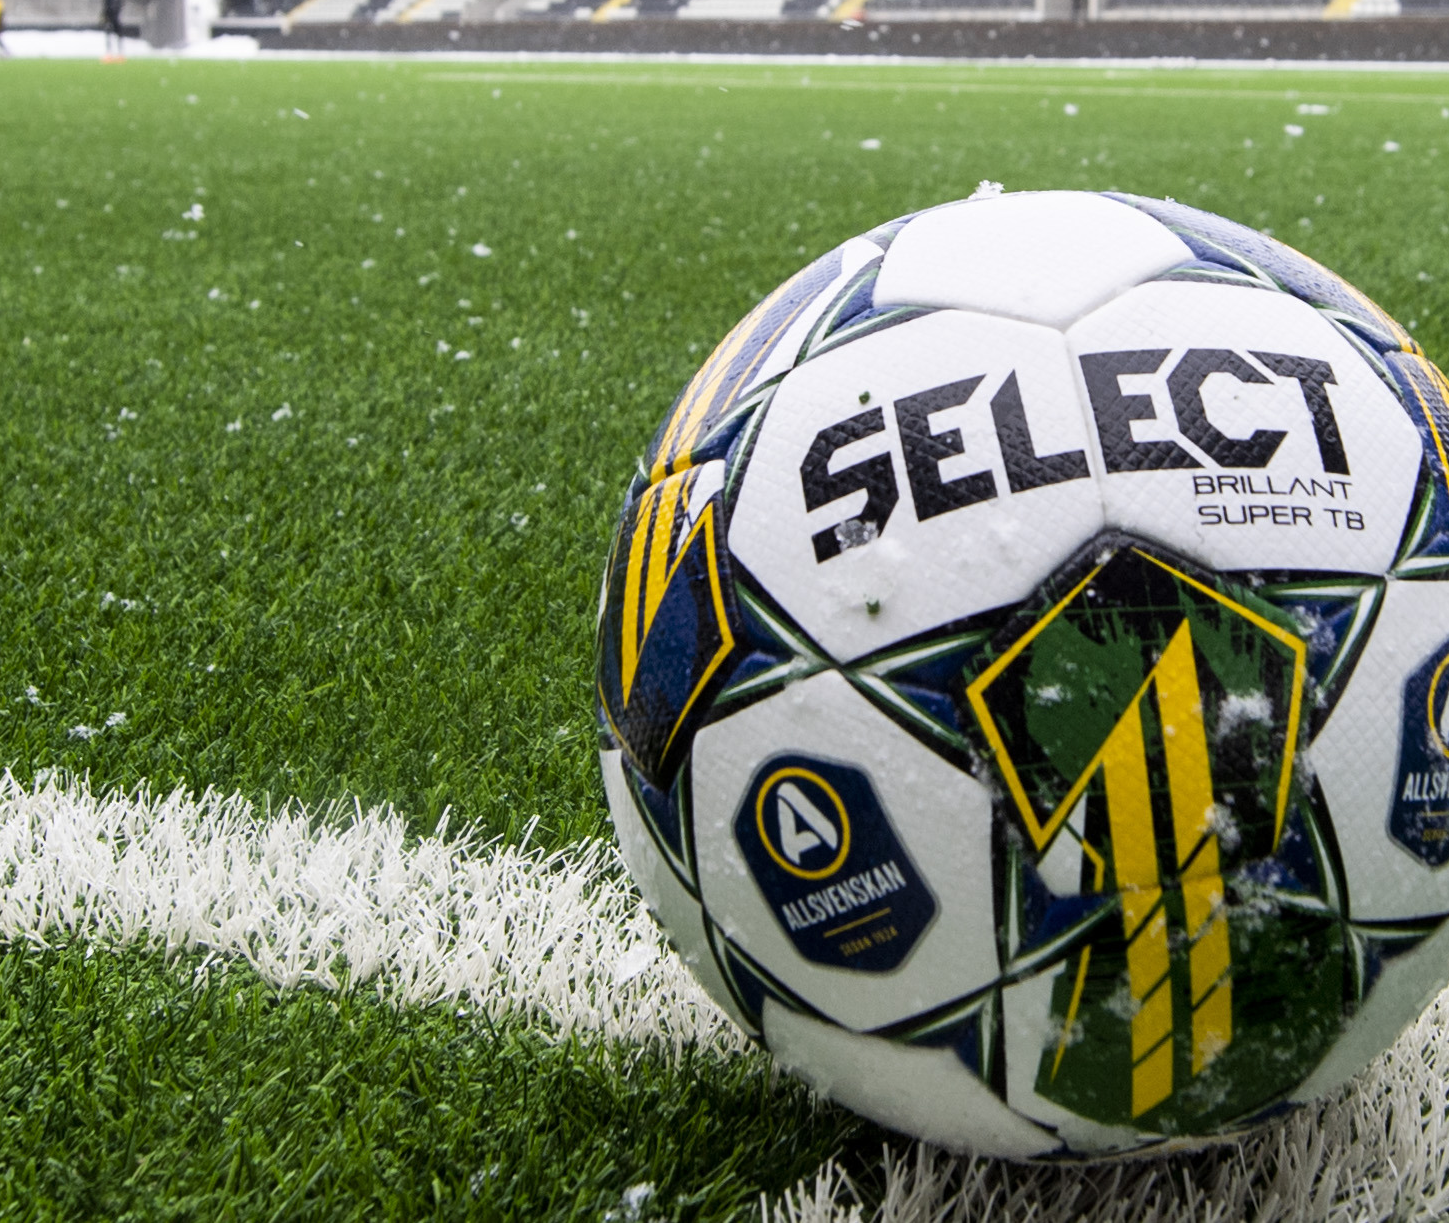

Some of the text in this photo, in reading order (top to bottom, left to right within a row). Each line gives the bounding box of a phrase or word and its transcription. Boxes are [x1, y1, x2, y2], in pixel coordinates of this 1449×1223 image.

[799, 347, 1351, 564] SELECT
[1192, 475, 1353, 500] BRILLANT
[1198, 505, 1366, 531] SUPER TB
[781, 860, 907, 932] ALLSVENSKAN
